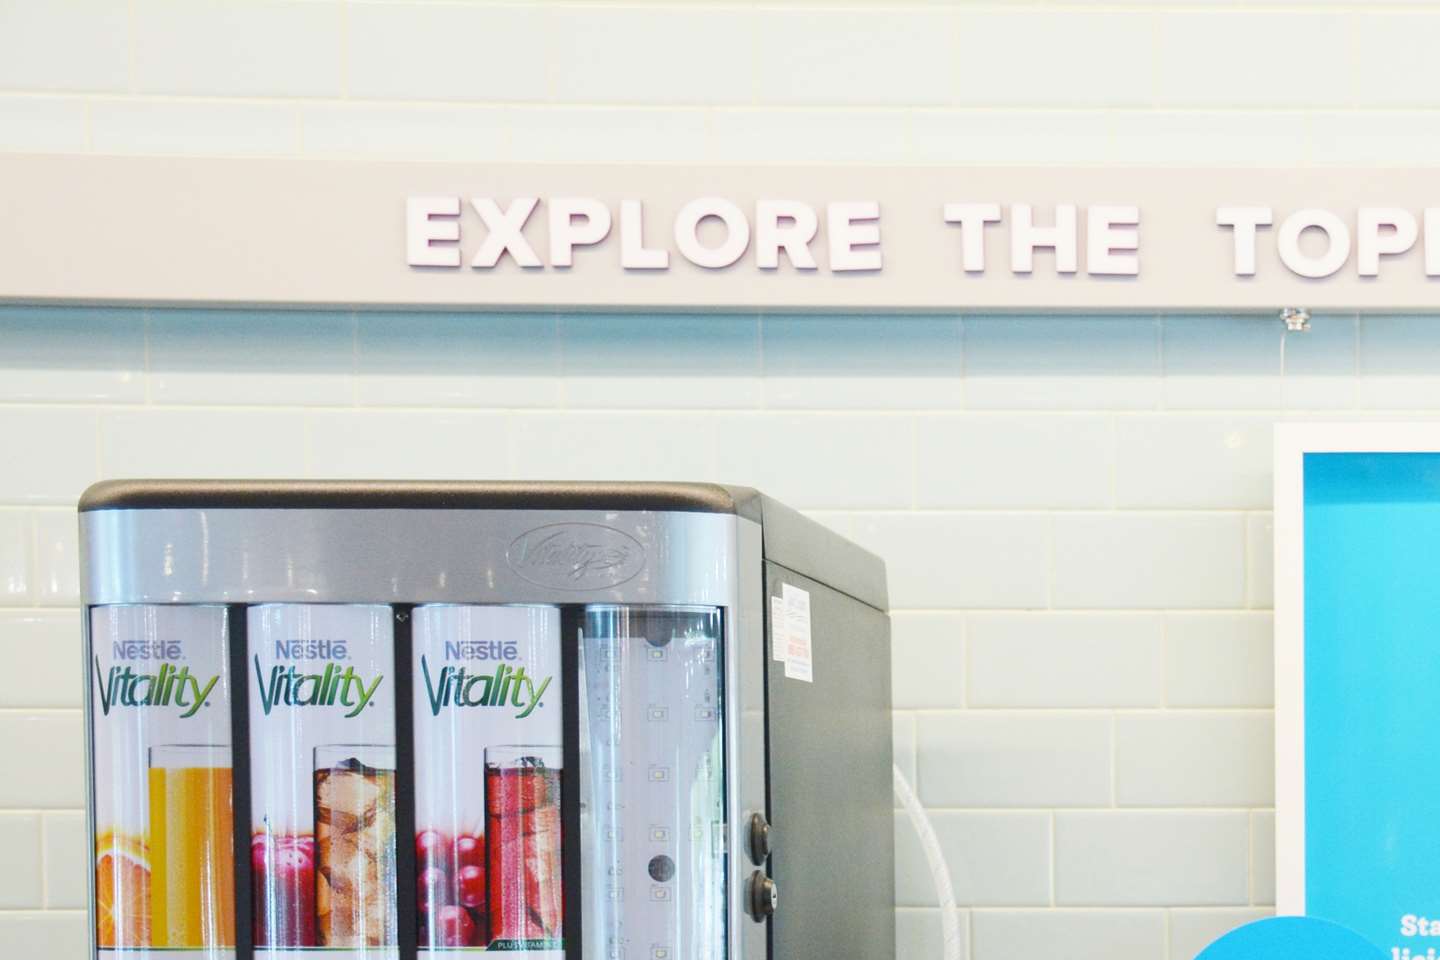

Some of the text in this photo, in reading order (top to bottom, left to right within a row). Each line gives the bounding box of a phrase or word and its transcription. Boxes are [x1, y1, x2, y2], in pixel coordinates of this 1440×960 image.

[406, 198, 884, 272] EXPLORE
[943, 202, 1141, 276] THE
[95, 653, 221, 719] Vitality
[254, 653, 385, 719] Vitality
[422, 653, 553, 719] Vitality
